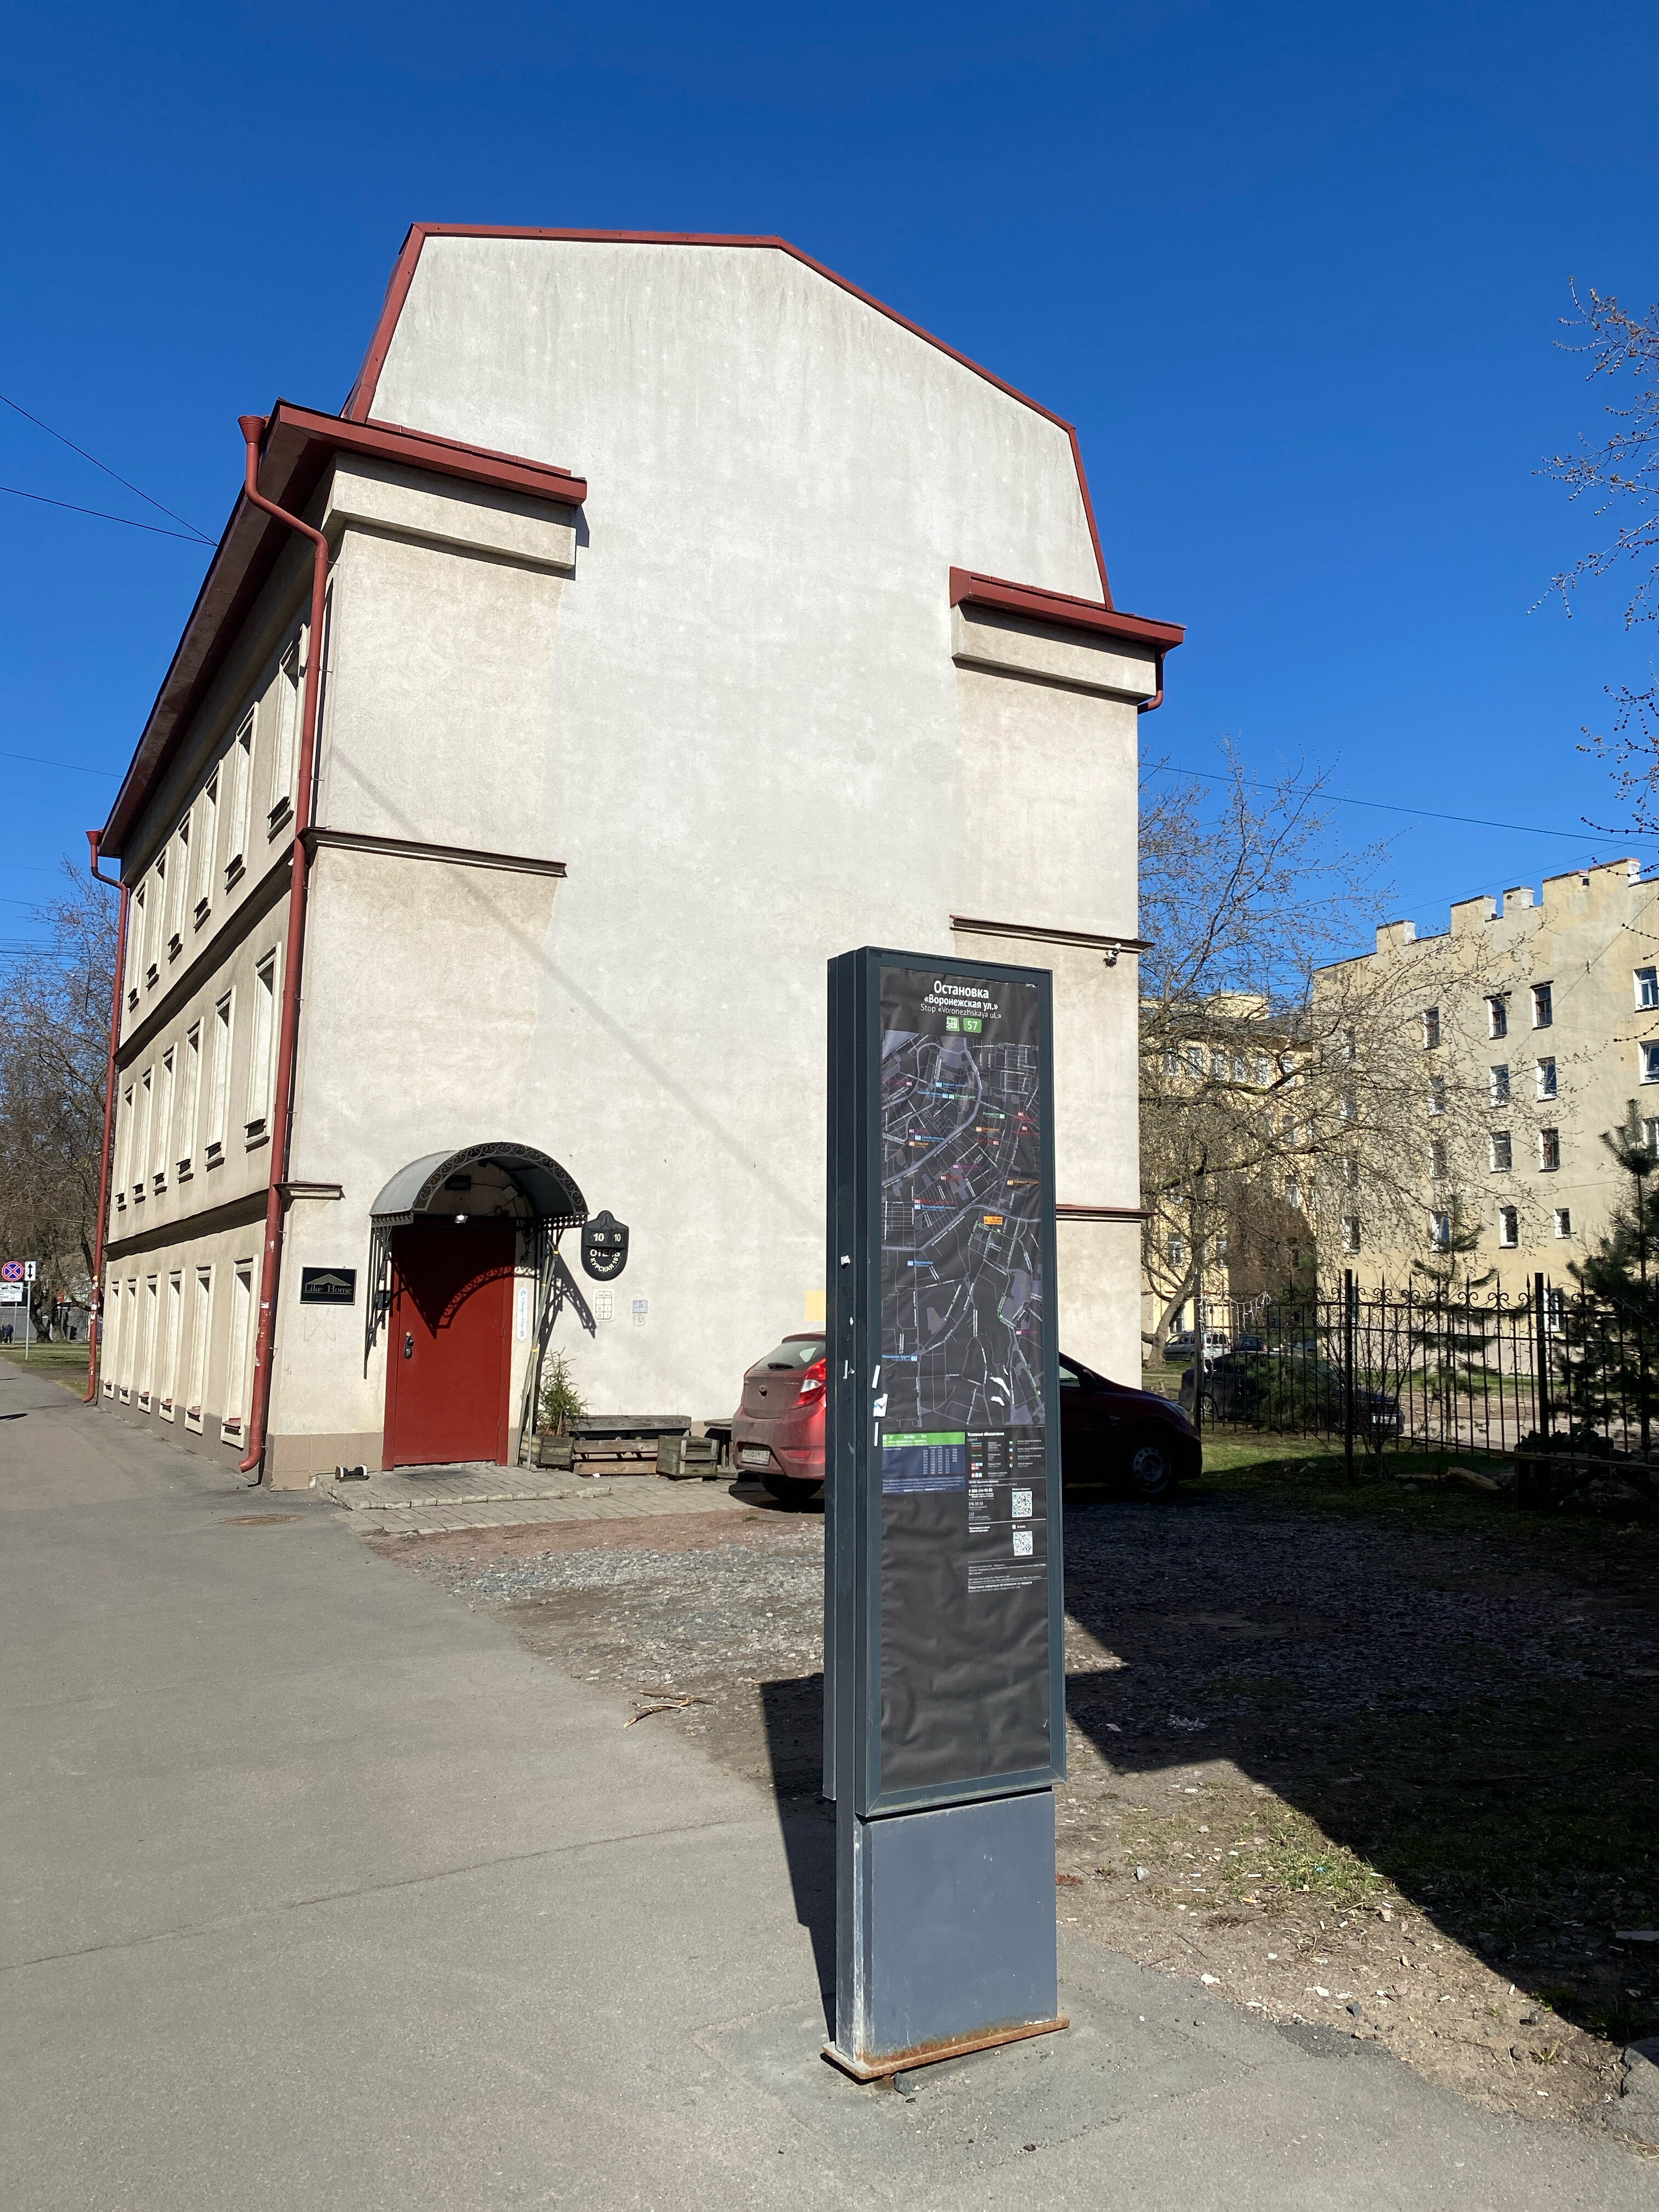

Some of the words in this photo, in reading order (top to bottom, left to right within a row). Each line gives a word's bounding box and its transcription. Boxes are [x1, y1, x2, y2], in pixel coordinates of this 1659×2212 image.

[934, 980, 989, 999] Остановка
[924, 994, 981, 1009] «Воронежская
[983, 1002, 998, 1011] ул.»
[921, 1003, 936, 1013] Stop
[938, 1006, 988, 1019] «Voronezhskaya
[967, 1020, 978, 1030] 57
[593, 1233, 605, 1242] 10
[614, 1233, 621, 1242] 10
[590, 1249, 620, 1257] ОТЕЛЬ
[590, 1257, 614, 1272] КУРСКАЯ
[327, 1285, 352, 1293] Home
